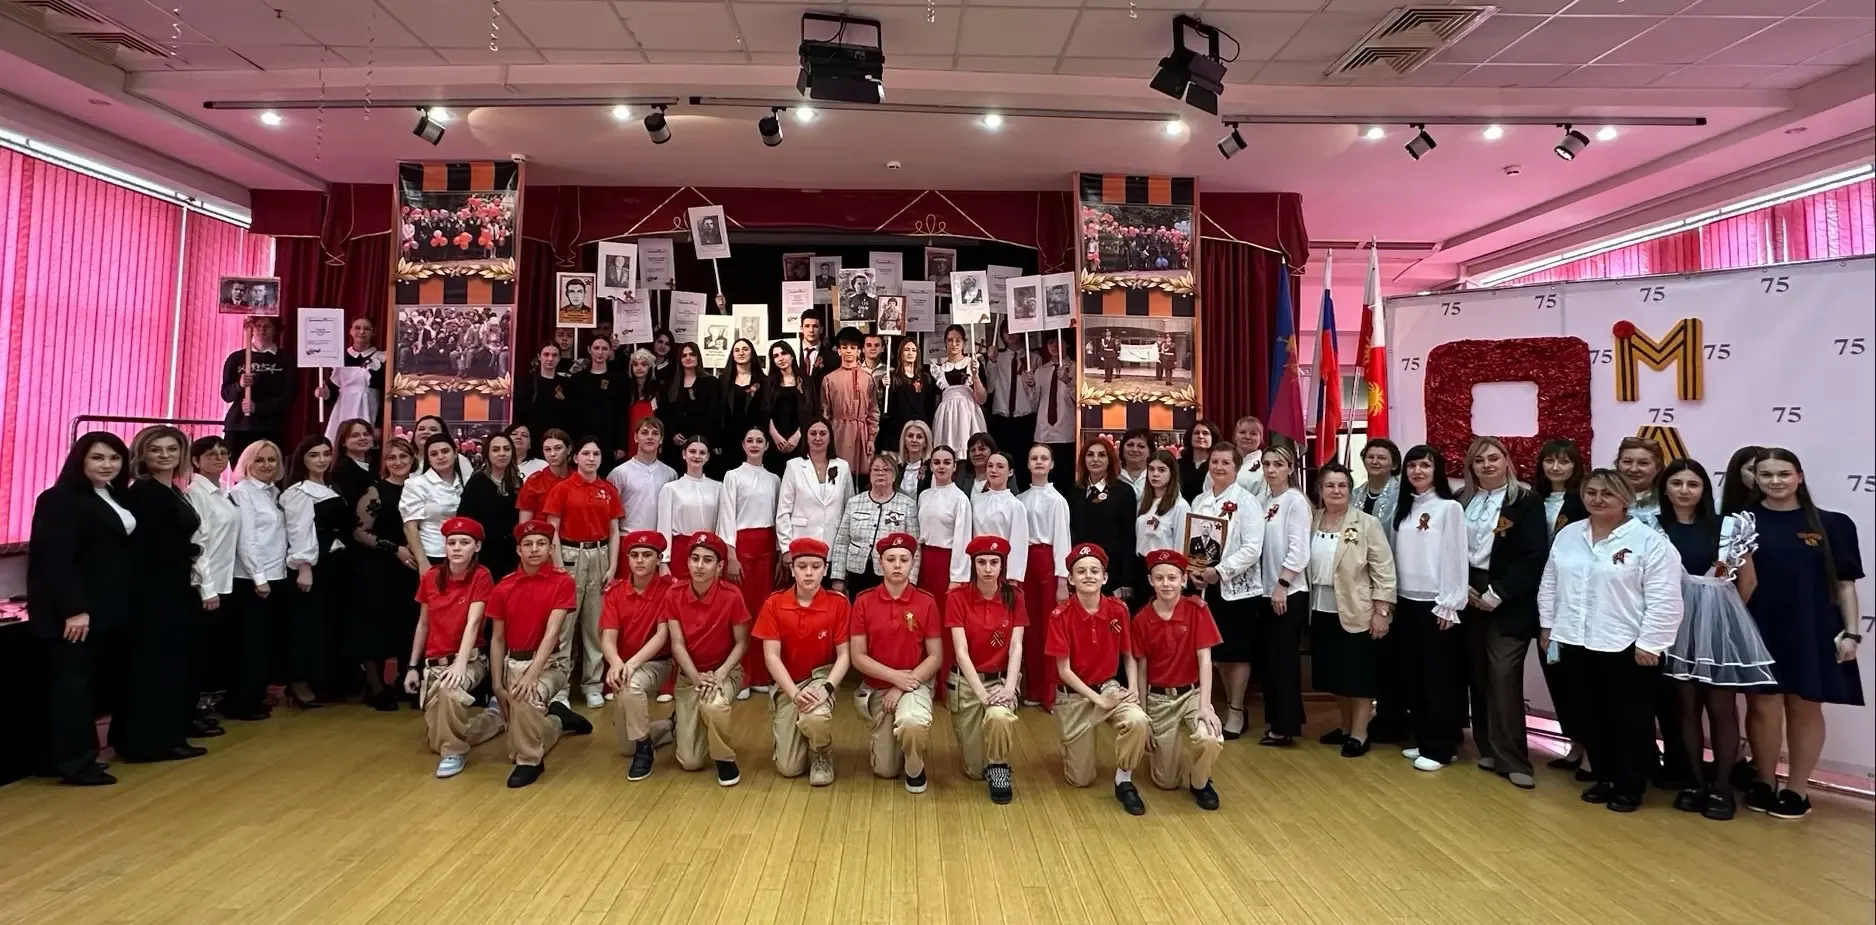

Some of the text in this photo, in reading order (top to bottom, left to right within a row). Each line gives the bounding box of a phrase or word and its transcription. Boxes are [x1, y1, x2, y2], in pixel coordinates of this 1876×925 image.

[1761, 277, 1790, 294] 75
[1535, 293, 1558, 310] 75
[1640, 286, 1666, 303] 75
[1441, 301, 1462, 317] 75
[1703, 343, 1731, 361] 75
[1834, 338, 1867, 356] 75
[1401, 357, 1421, 372] 75
[1589, 349, 1613, 365] 75
[1648, 407, 1675, 424] 75
[1772, 406, 1802, 424] 75
[1847, 474, 1875, 493] 75
